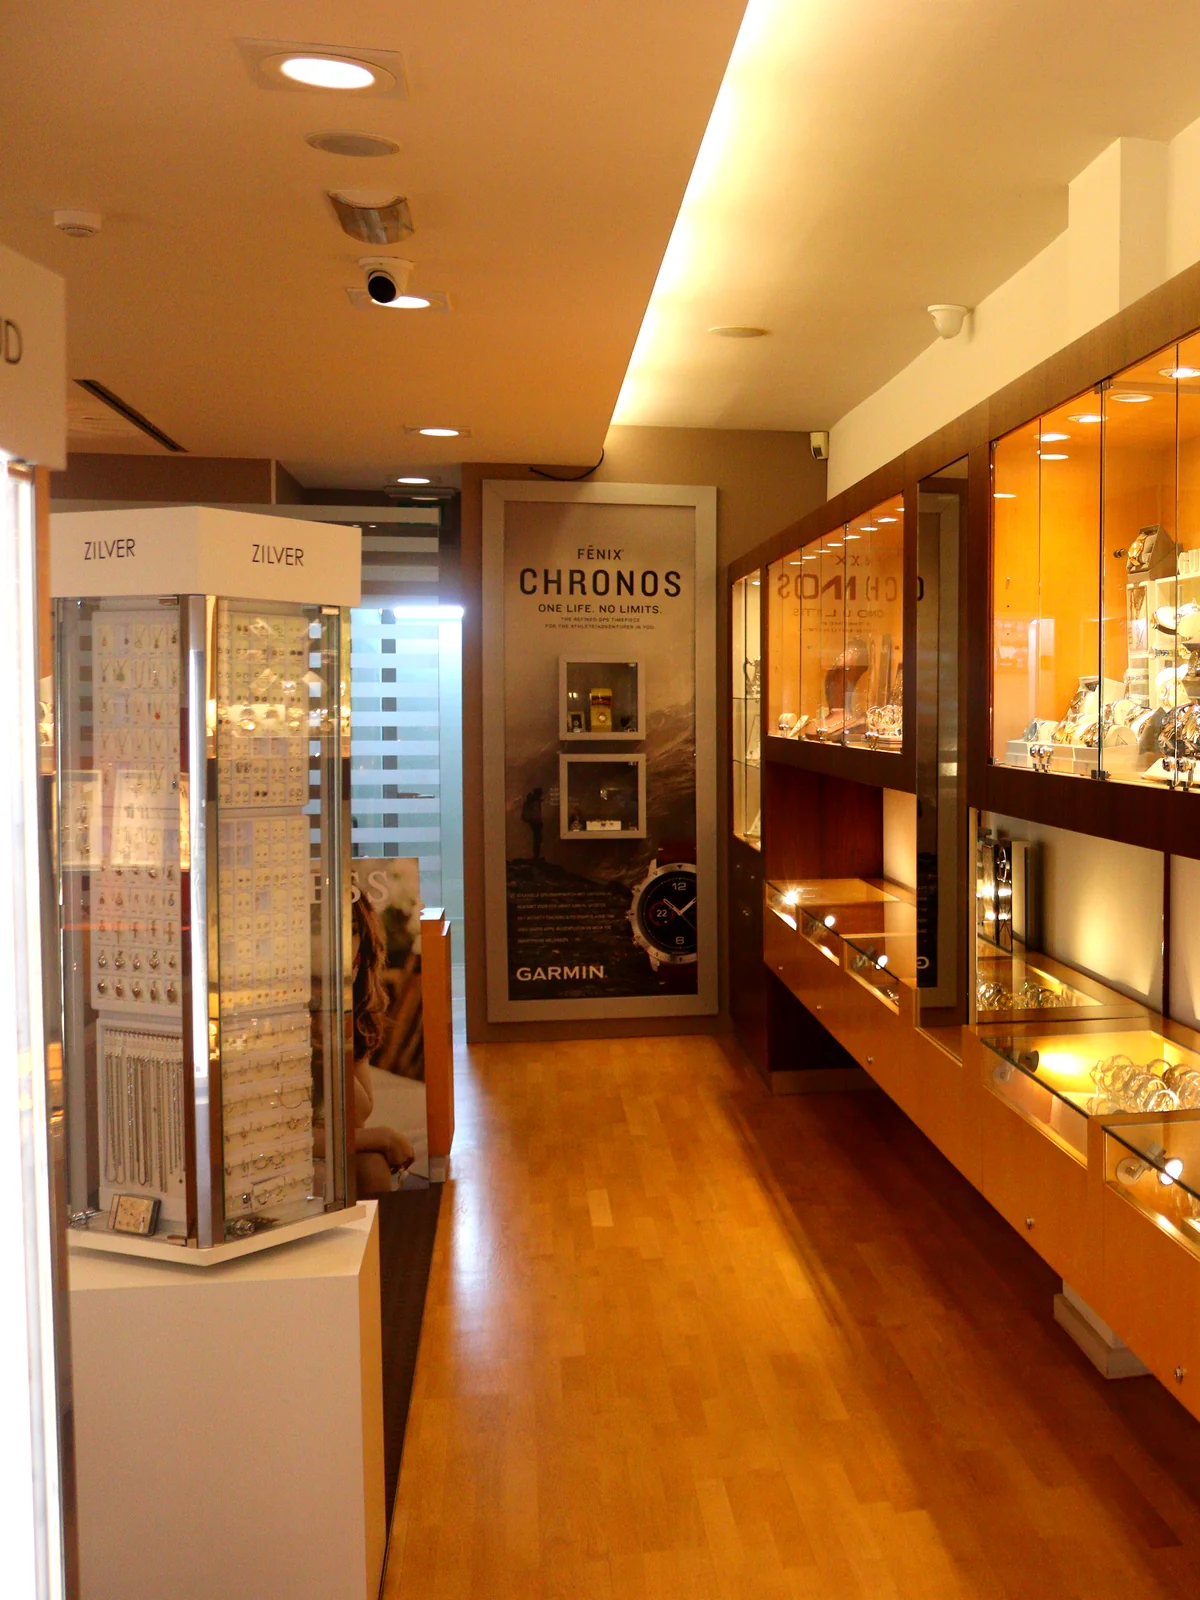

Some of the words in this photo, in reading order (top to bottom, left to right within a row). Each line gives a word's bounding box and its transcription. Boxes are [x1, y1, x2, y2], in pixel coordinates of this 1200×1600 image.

[0, 316, 23, 366] D
[83, 538, 136, 561] ZILVER
[251, 543, 304, 567] ZILVER
[519, 567, 682, 598] CHRONOS
[538, 603, 562, 613] ONE
[566, 604, 595, 613] LIFE.
[599, 604, 616, 614] NO
[619, 605, 663, 614] LIMITS.
[671, 882, 687, 891] 12
[656, 909, 668, 918] 22
[675, 936, 685, 945] 6
[516, 964, 606, 981] GARMIN
